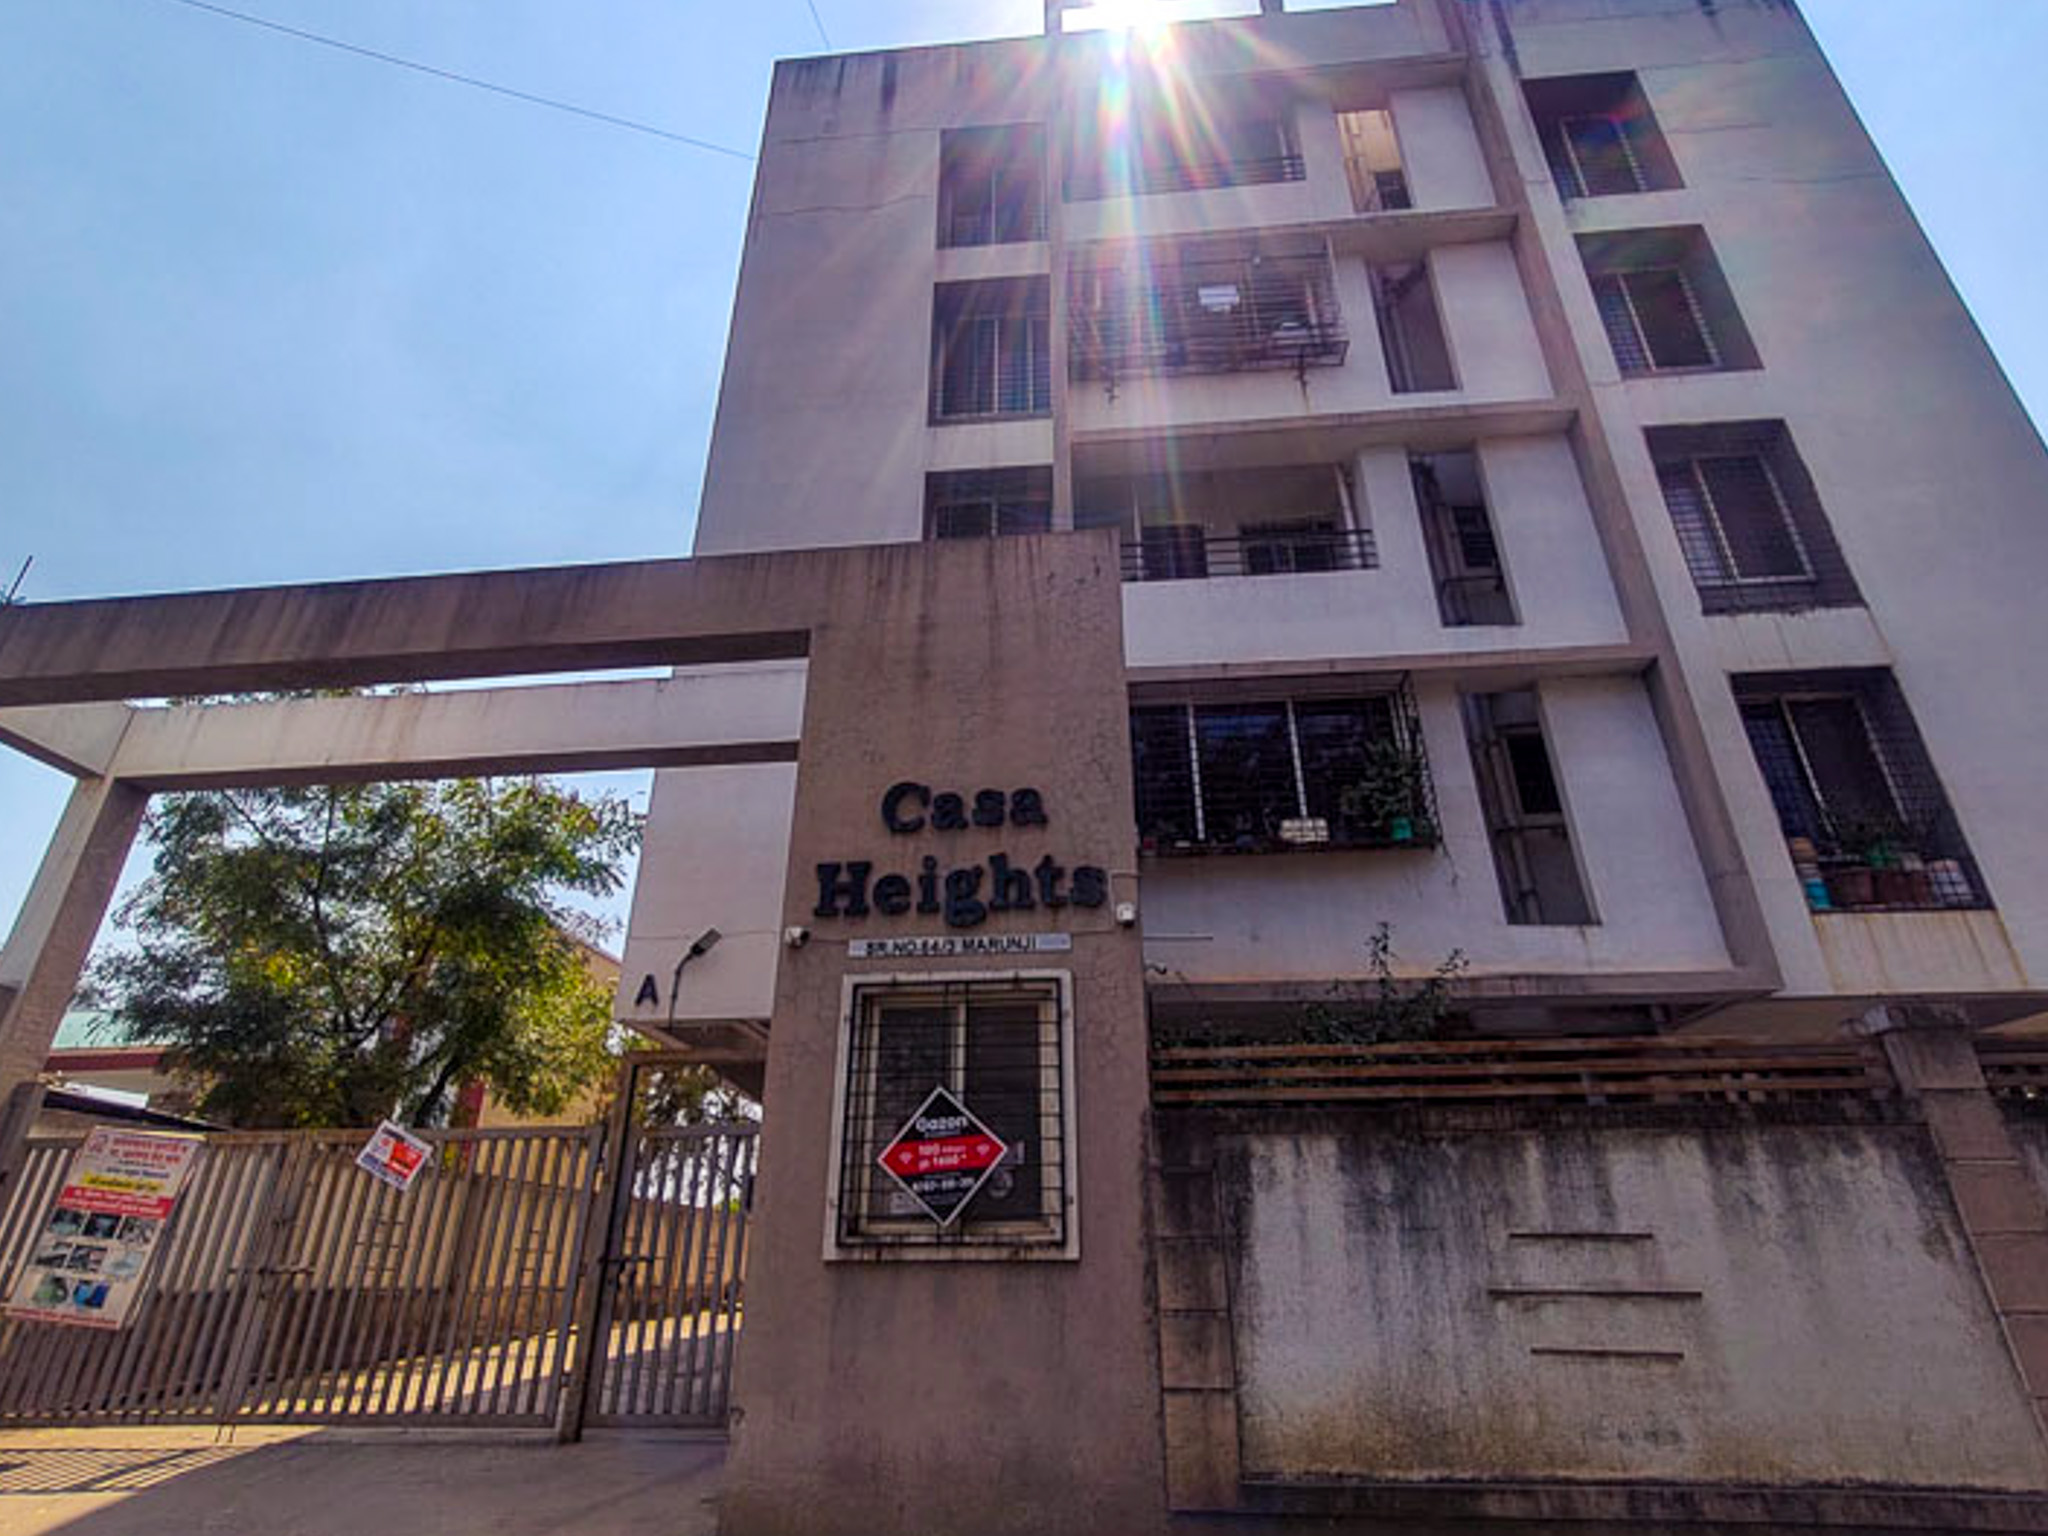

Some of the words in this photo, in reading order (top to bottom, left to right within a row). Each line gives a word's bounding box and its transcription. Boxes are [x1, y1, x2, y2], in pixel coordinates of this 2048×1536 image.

[881, 781, 1048, 834] Casa
[813, 852, 1109, 928] Heights
[634, 973, 659, 1007] A
